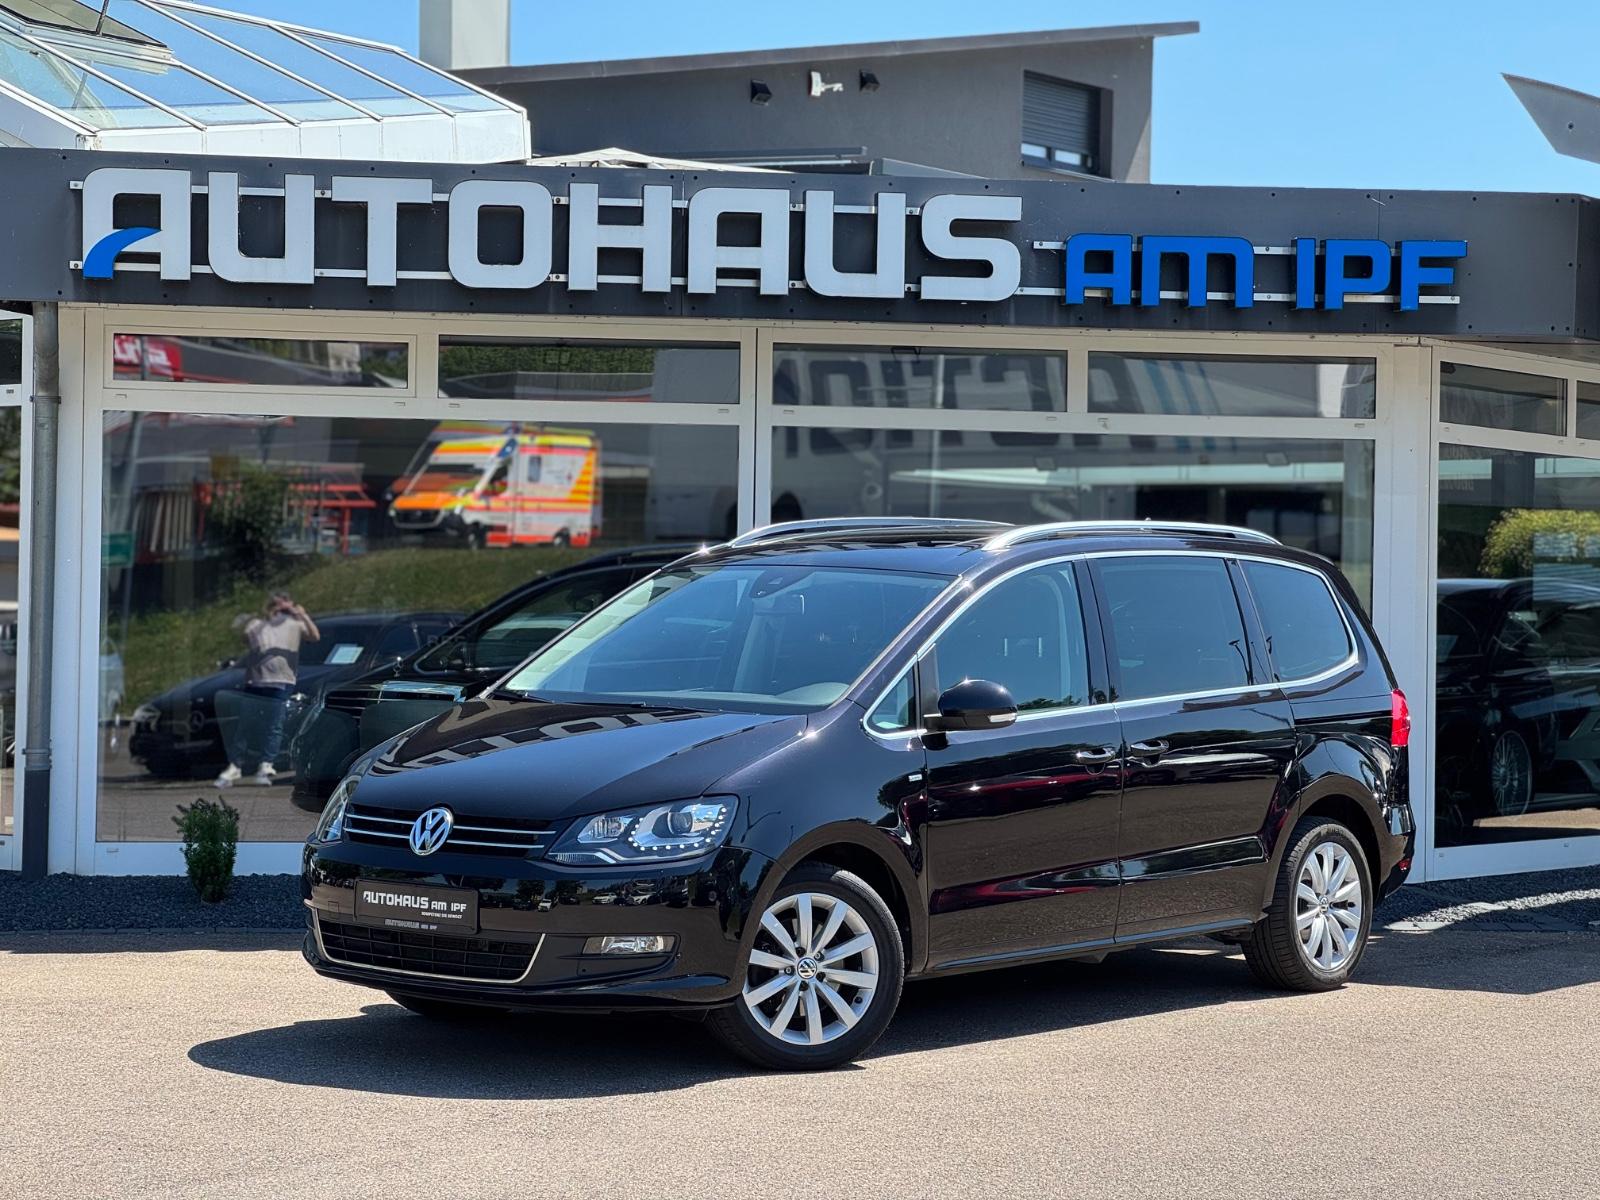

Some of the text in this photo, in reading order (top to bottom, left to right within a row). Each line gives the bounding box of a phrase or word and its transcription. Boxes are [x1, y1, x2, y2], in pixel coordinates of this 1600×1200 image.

[81, 166, 1469, 312] AUTOHAUS AM IPF
[363, 890, 429, 909] AUTOHAUS
[451, 902, 468, 913] IPF
